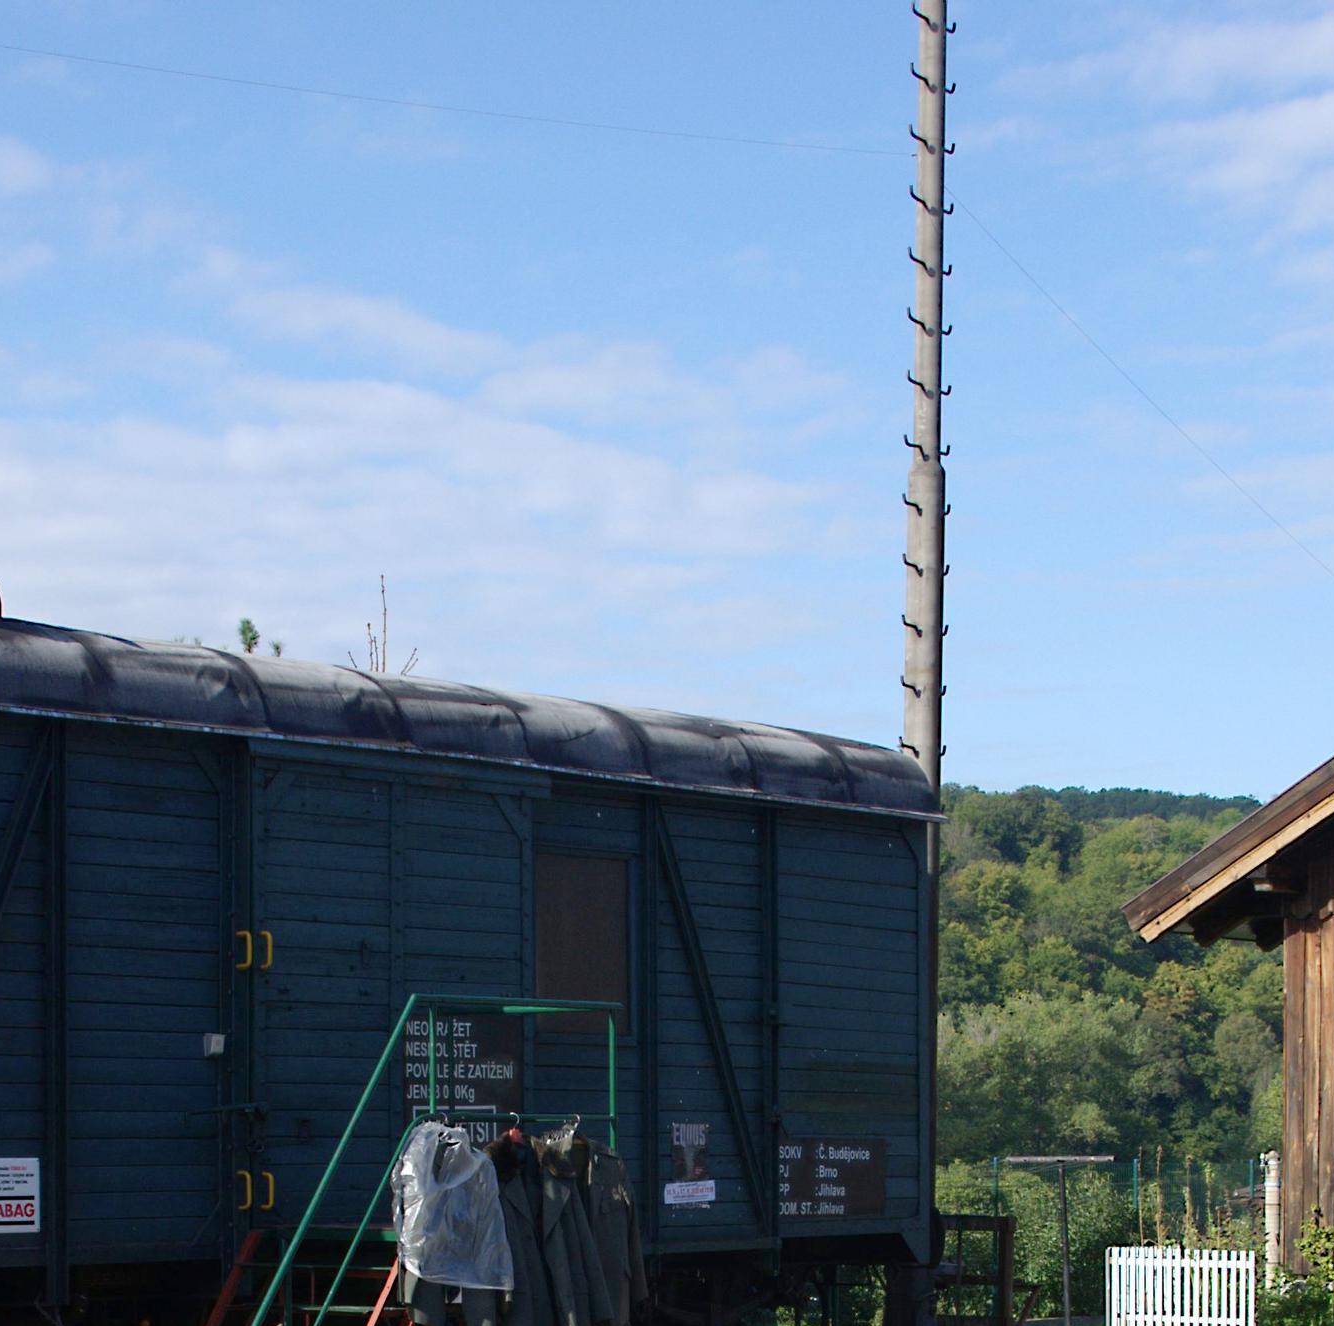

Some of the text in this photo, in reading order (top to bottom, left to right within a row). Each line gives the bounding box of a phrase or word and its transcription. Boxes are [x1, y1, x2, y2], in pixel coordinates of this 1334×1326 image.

[406, 1018, 472, 1037] NEORAŽET
[406, 1060, 514, 1079] POVLENÉ ZATÍŽENÍ
[443, 1084, 475, 1103] 00Kg
[779, 1145, 802, 1159] SOKV
[828, 1145, 870, 1163] Budějovice
[779, 1164, 789, 1178] PJ
[779, 1183, 790, 1196] PP
